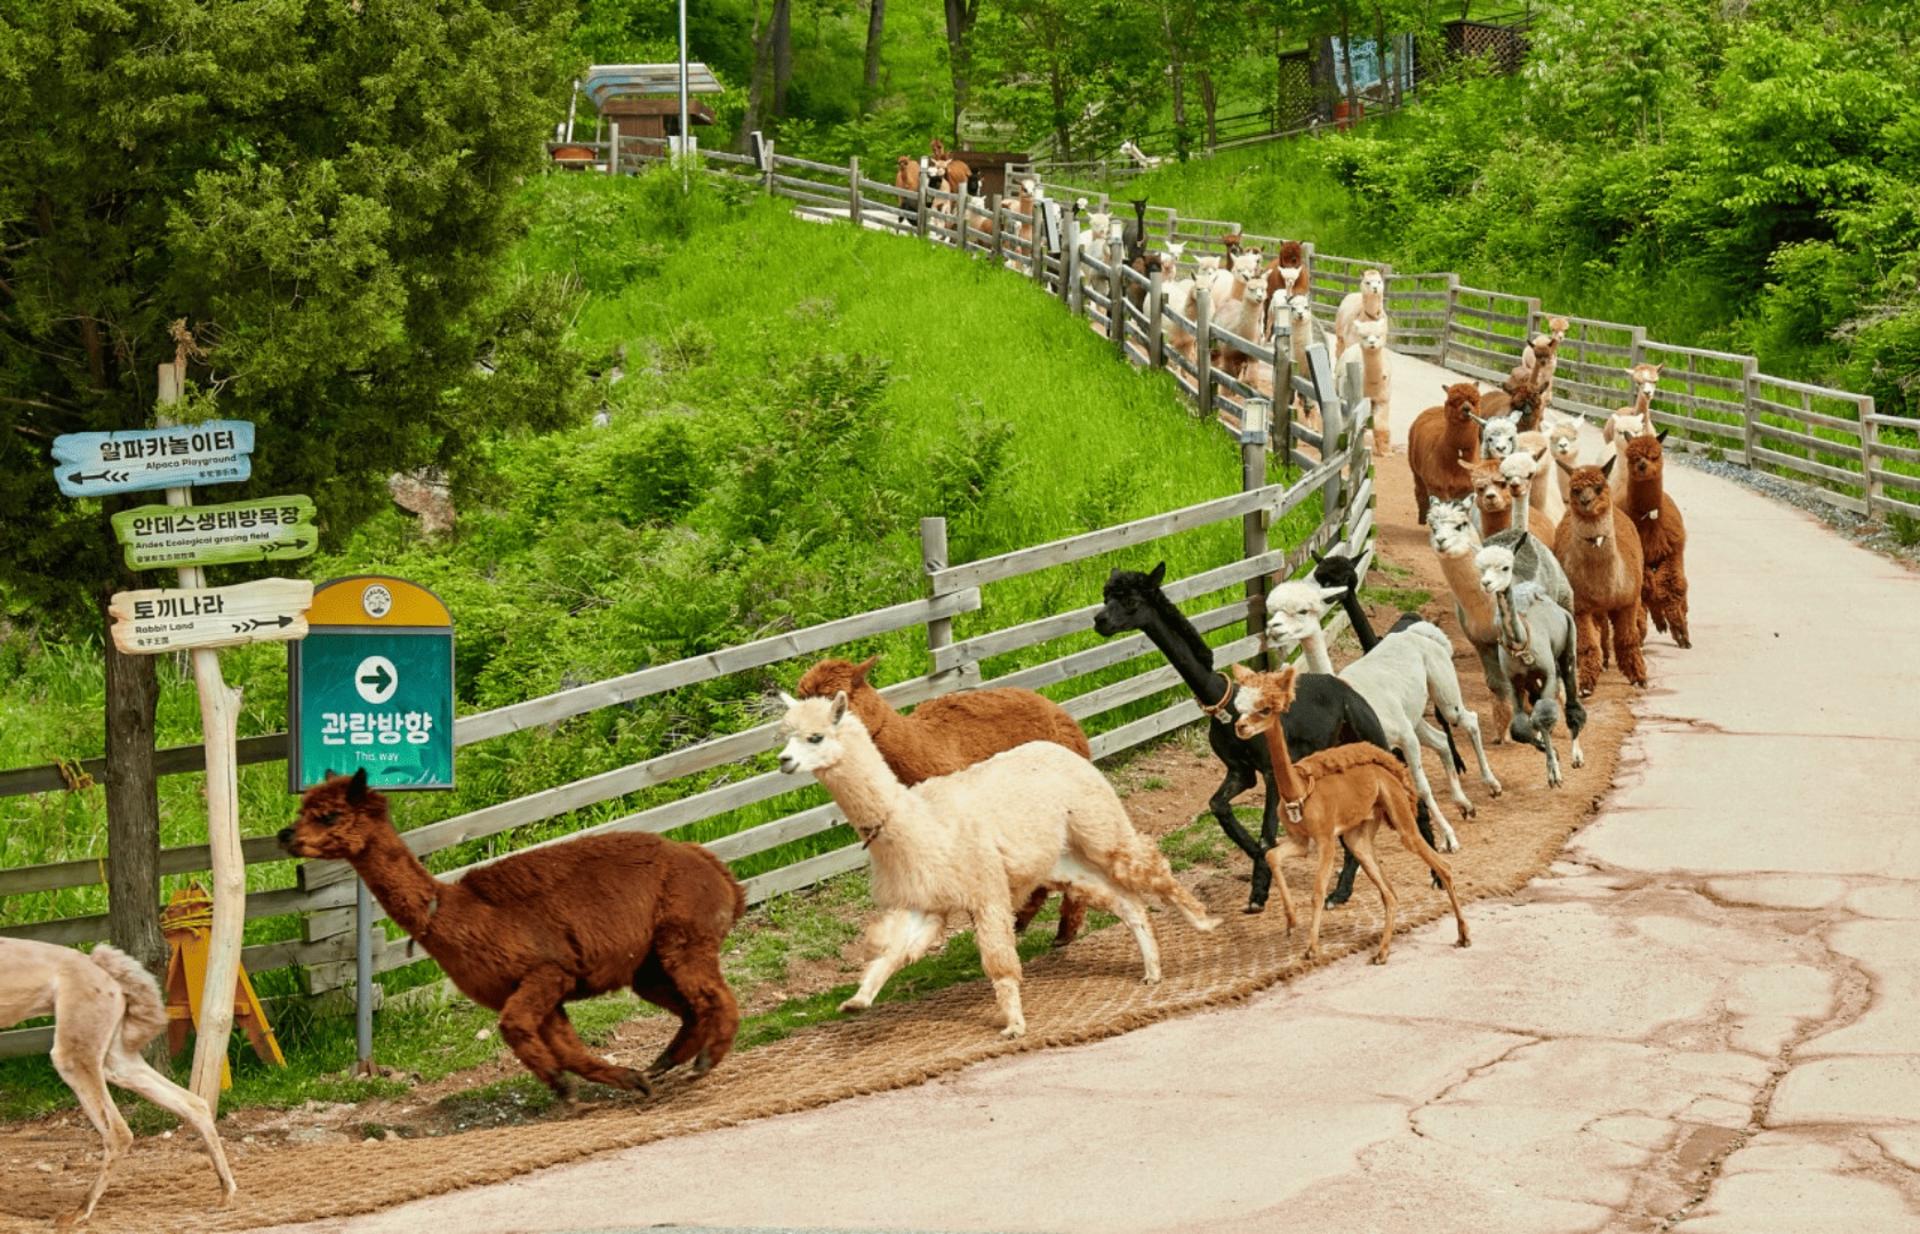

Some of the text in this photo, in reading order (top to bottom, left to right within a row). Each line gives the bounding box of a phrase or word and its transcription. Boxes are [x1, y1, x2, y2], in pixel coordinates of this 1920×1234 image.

[100, 431, 235, 462] 알파카놀이터
[146, 454, 237, 470] Alpaca Playground
[133, 506, 300, 537] 안데스생태방목장
[135, 531, 269, 549] Andes Ecological grazing field
[134, 594, 224, 620] 토끼나라
[135, 621, 195, 634] Rabbit Land
[321, 711, 433, 745] 관람방향
[355, 751, 399, 762] This way
